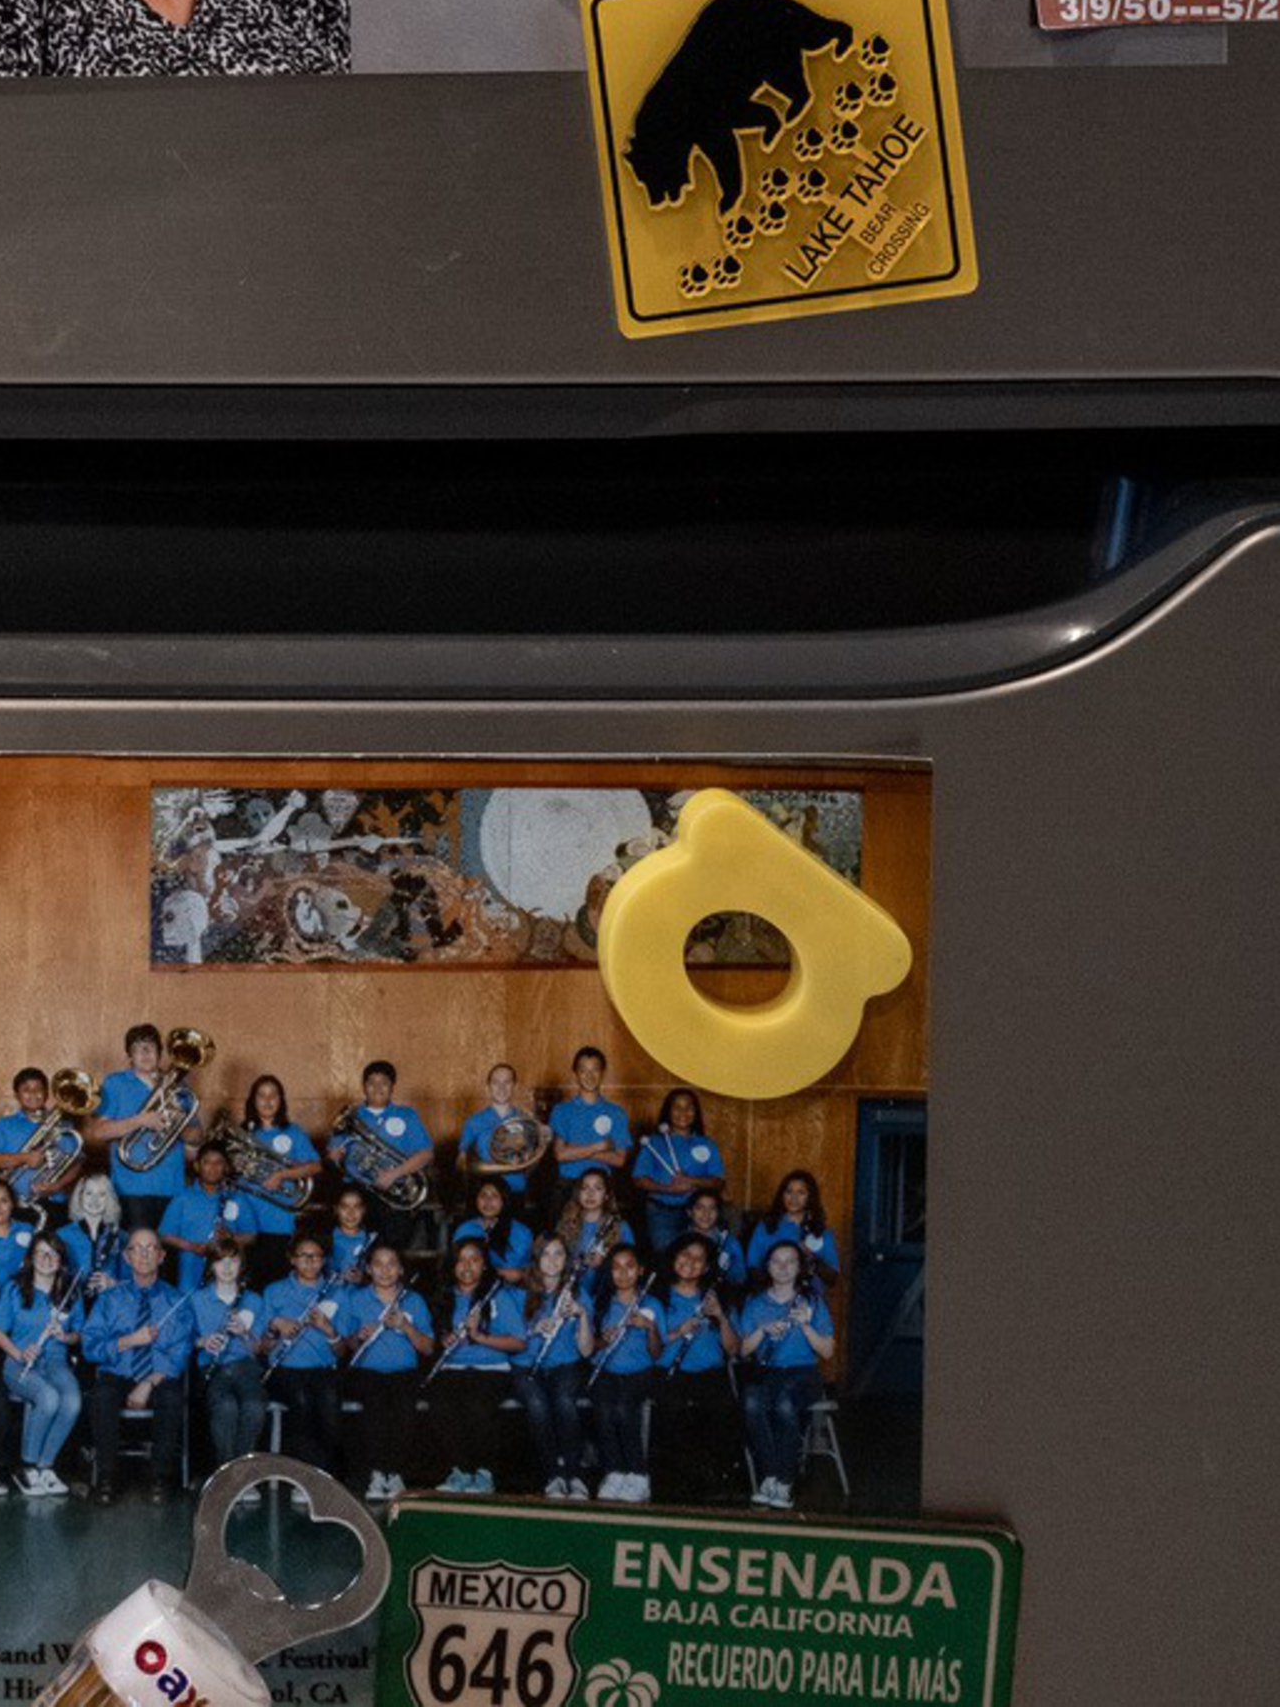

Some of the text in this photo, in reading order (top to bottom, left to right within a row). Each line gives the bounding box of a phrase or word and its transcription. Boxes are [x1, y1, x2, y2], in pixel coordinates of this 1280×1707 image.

[783, 111, 929, 288] LAKE TAHOE
[857, 200, 900, 246] BEAR
[867, 199, 933, 281] CROSSING
[428, 1569, 568, 1612] MEXICO
[612, 1540, 958, 1609] ENSENADA
[643, 1598, 914, 1639] BAJA CALIFORNIA
[278, 1645, 370, 1671] Festival
[427, 1623, 556, 1707] 646
[666, 1641, 962, 1704] RECUERDO PARA LA MÁS
